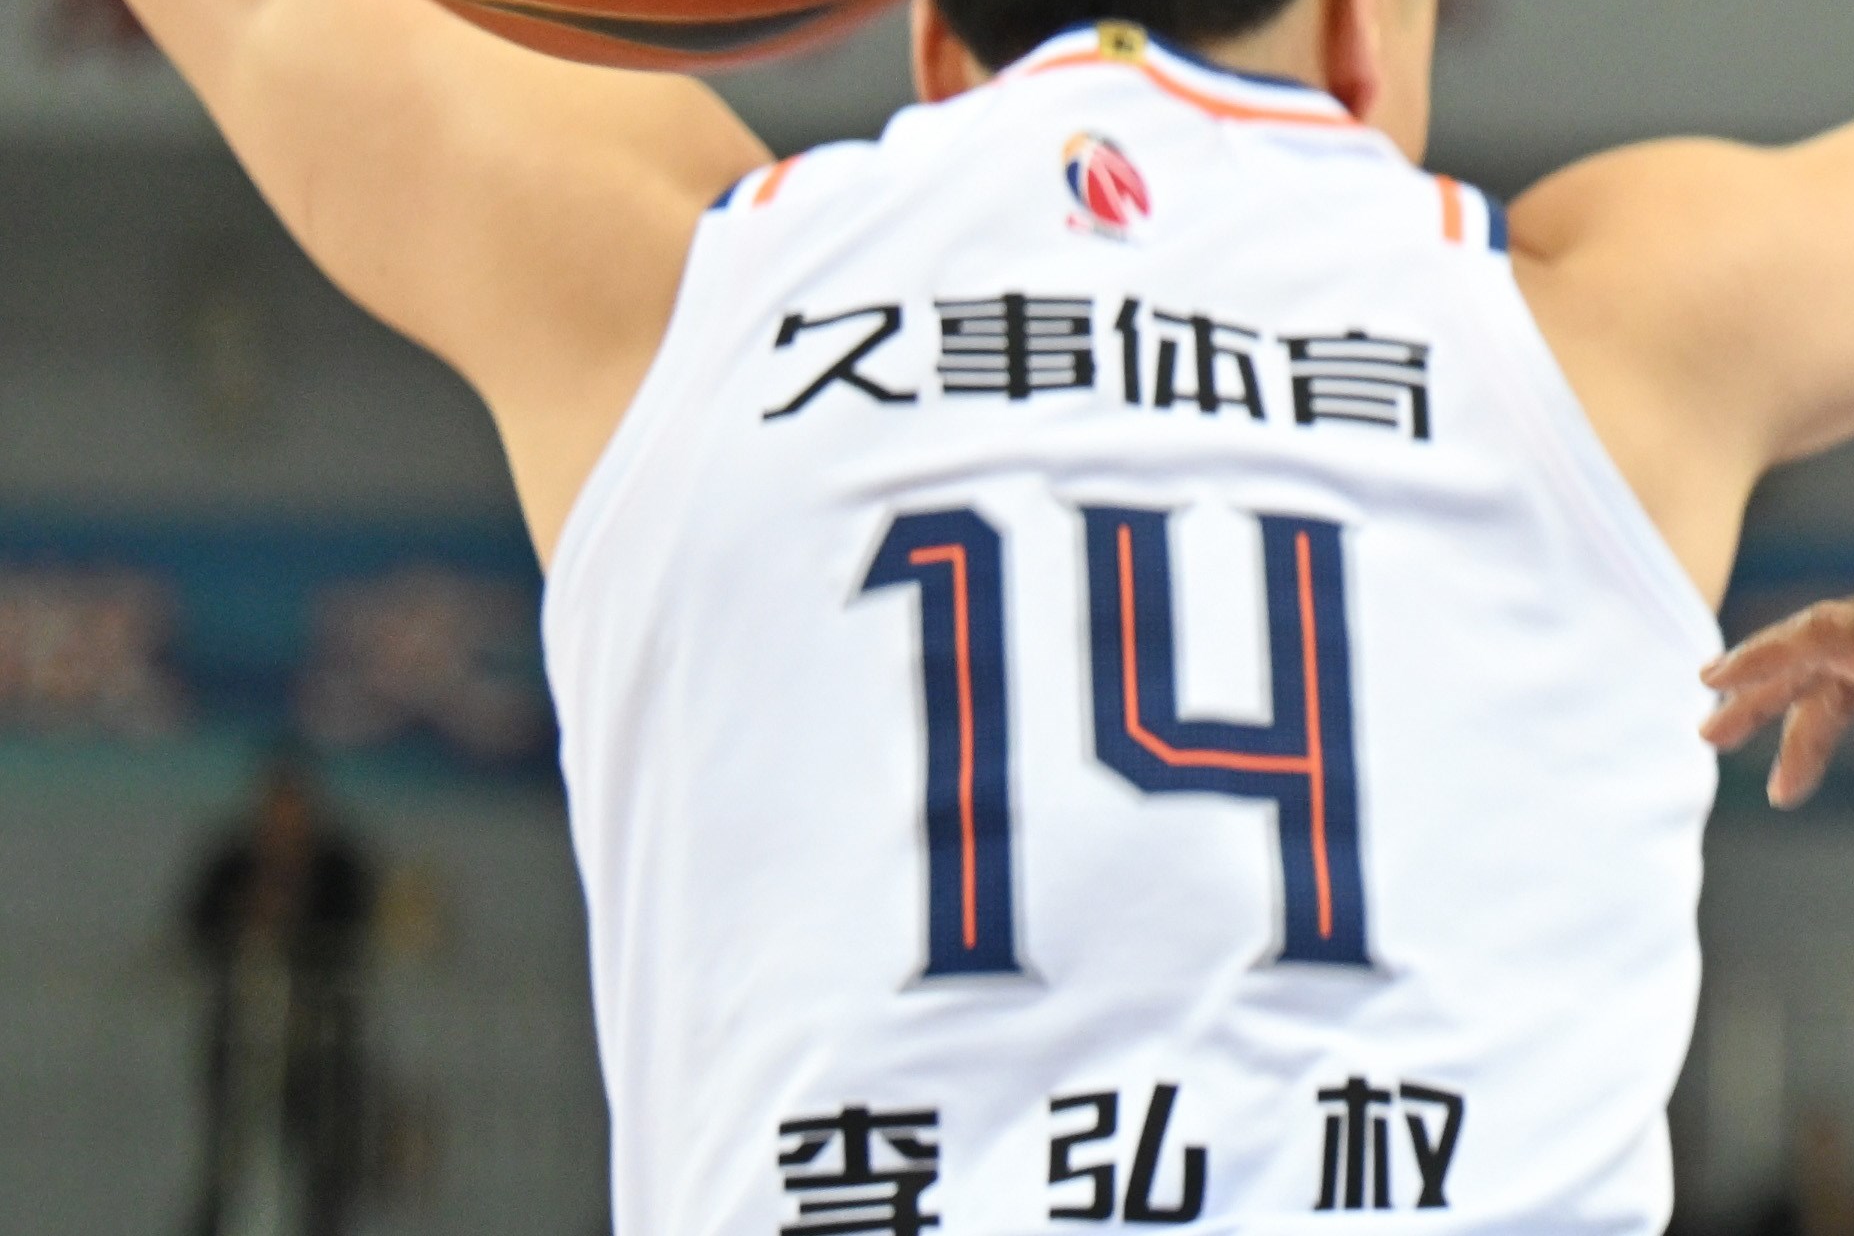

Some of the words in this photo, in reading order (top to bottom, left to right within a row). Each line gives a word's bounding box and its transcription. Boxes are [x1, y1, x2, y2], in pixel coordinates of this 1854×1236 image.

[762, 291, 1434, 442] 久事体育
[852, 499, 1385, 981] 14
